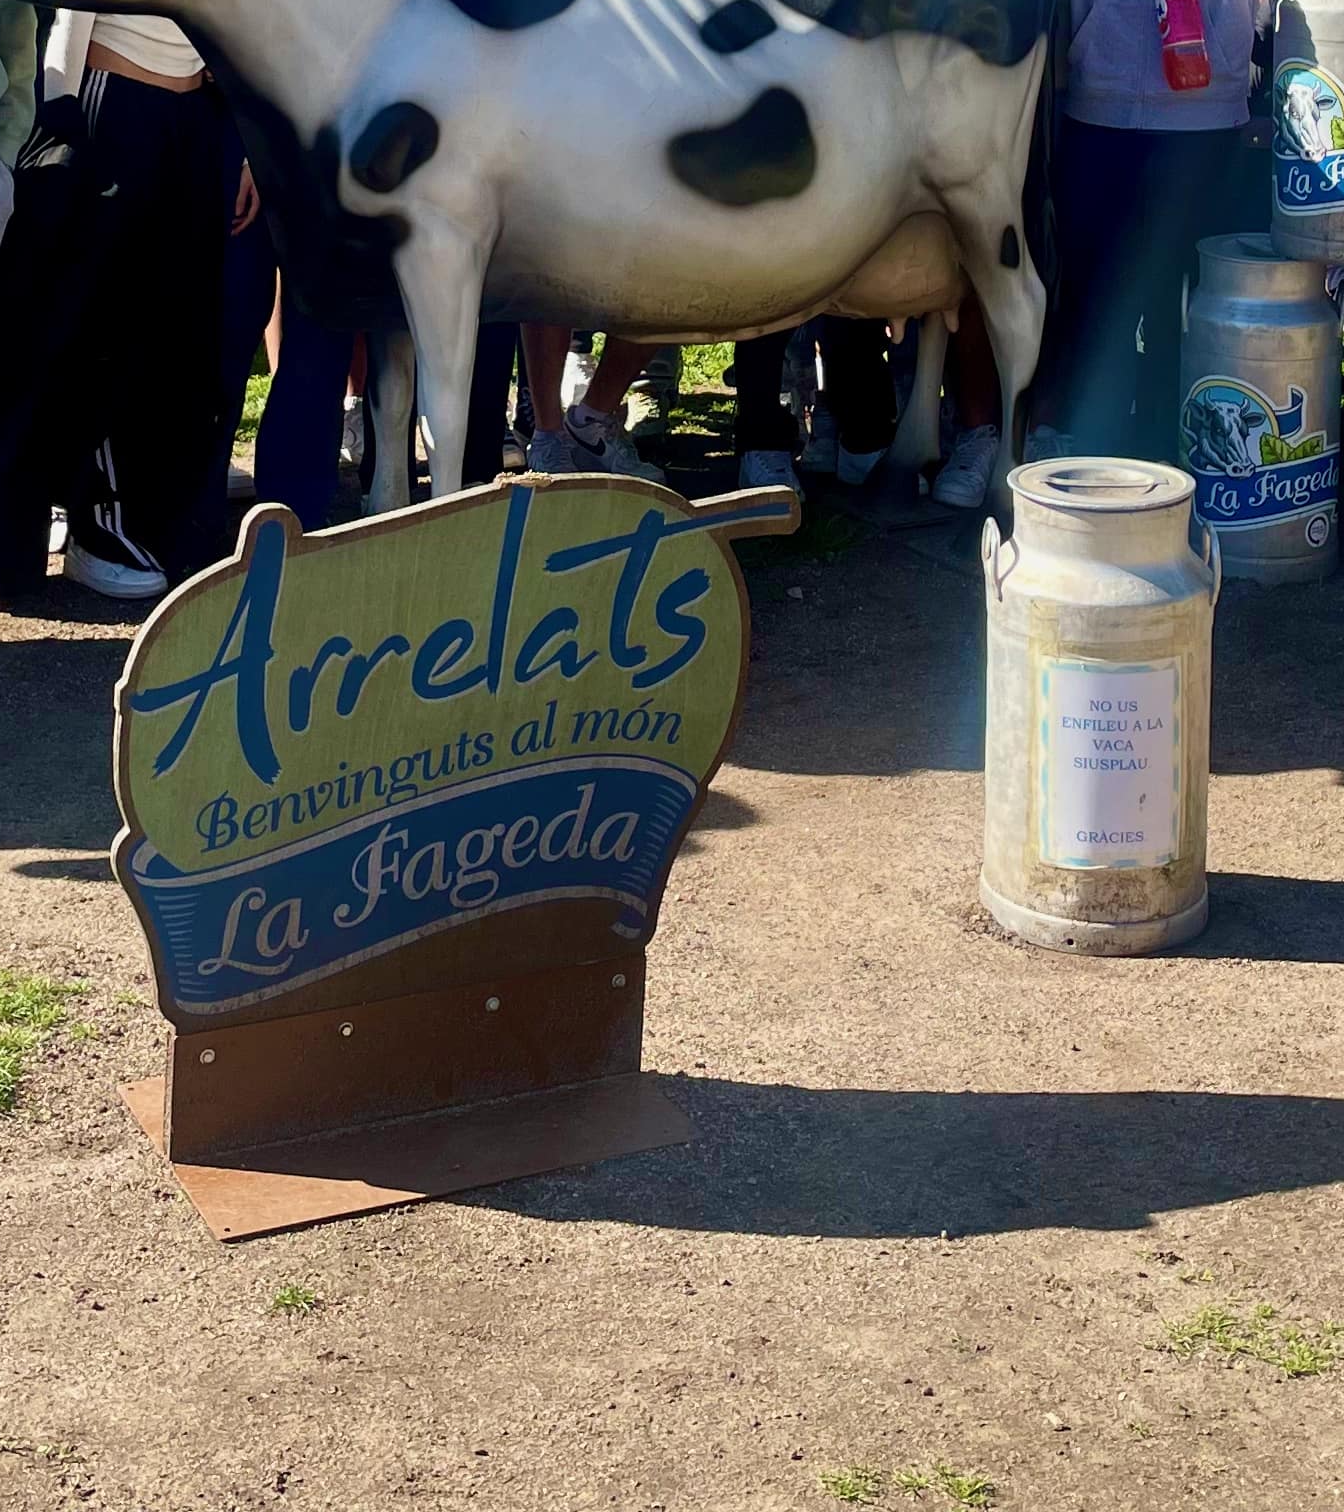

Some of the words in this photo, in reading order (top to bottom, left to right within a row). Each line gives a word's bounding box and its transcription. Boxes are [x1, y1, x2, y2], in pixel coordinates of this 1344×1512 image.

[1283, 166, 1312, 201] La
[1204, 482, 1241, 516] La
[130, 486, 792, 785] Arrelats
[1089, 700, 1113, 713] NO
[1117, 700, 1139, 713] US
[1062, 716, 1128, 732] ENFILEU
[1133, 719, 1143, 732] A
[1147, 717, 1164, 731] LA
[1093, 739, 1134, 752] VACA
[196, 731, 494, 854] Benvinguts
[511, 701, 557, 751] al
[571, 699, 682, 746] món
[197, 887, 310, 976] La
[333, 783, 641, 929] Fageda
